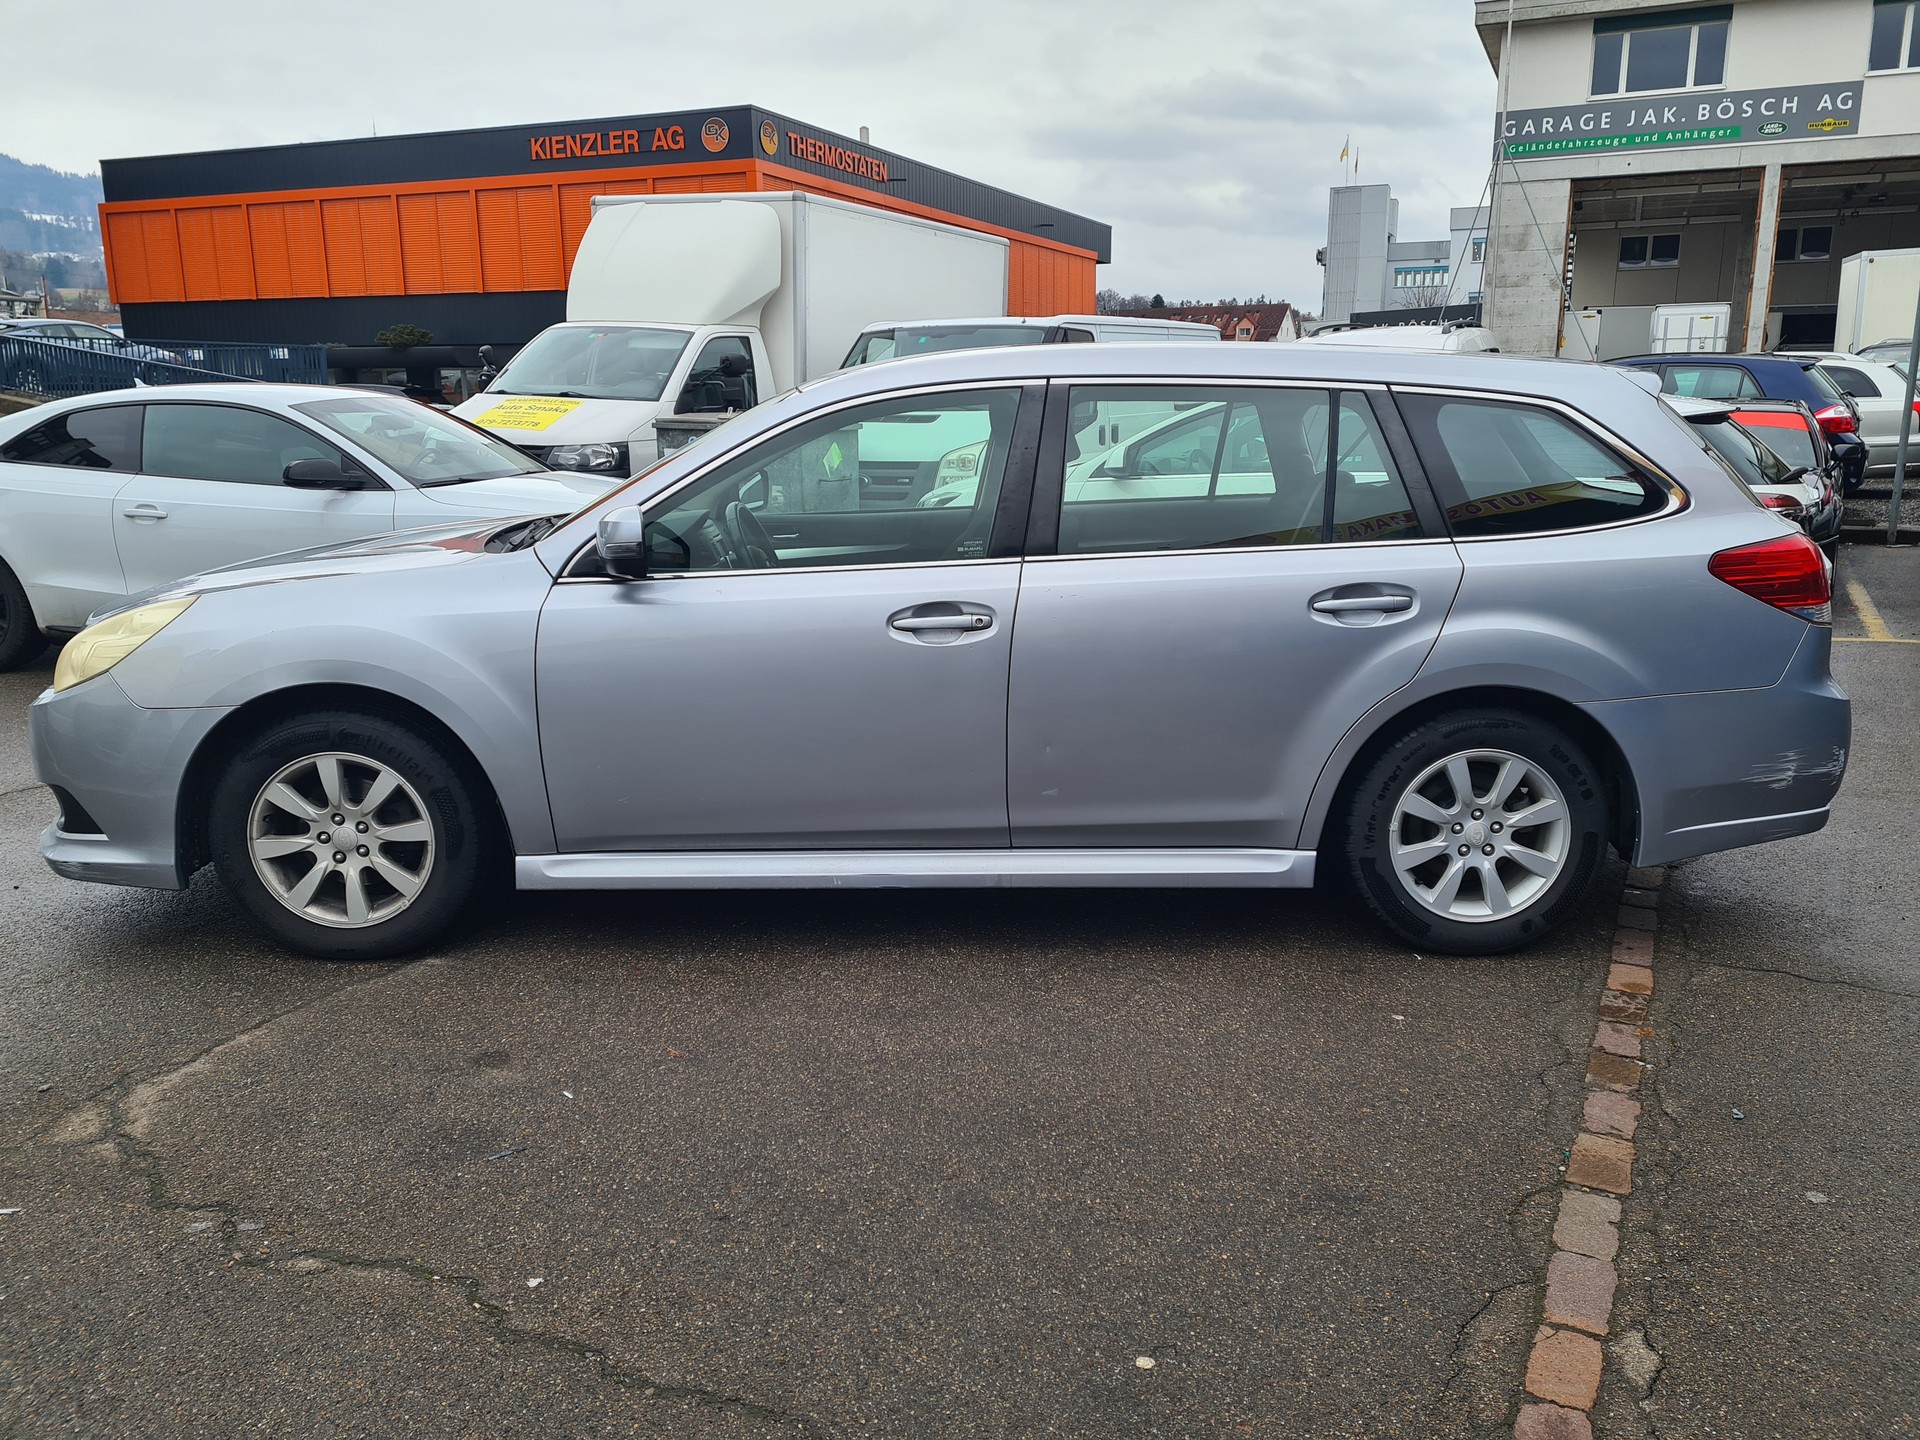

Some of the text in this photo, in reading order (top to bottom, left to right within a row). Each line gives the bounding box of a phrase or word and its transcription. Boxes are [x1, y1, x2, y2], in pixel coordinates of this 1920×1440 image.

[1504, 92, 1853, 137] GARAGE JAK. BÖSCH AG
[1808, 121, 1848, 129] HUMBAUR
[530, 125, 685, 161] KIENZLER AG
[1509, 128, 1732, 153] Geländefahrzeuge und Anhänger
[787, 131, 888, 183] THERMOSTATEN
[524, 404, 569, 414] Smaka
